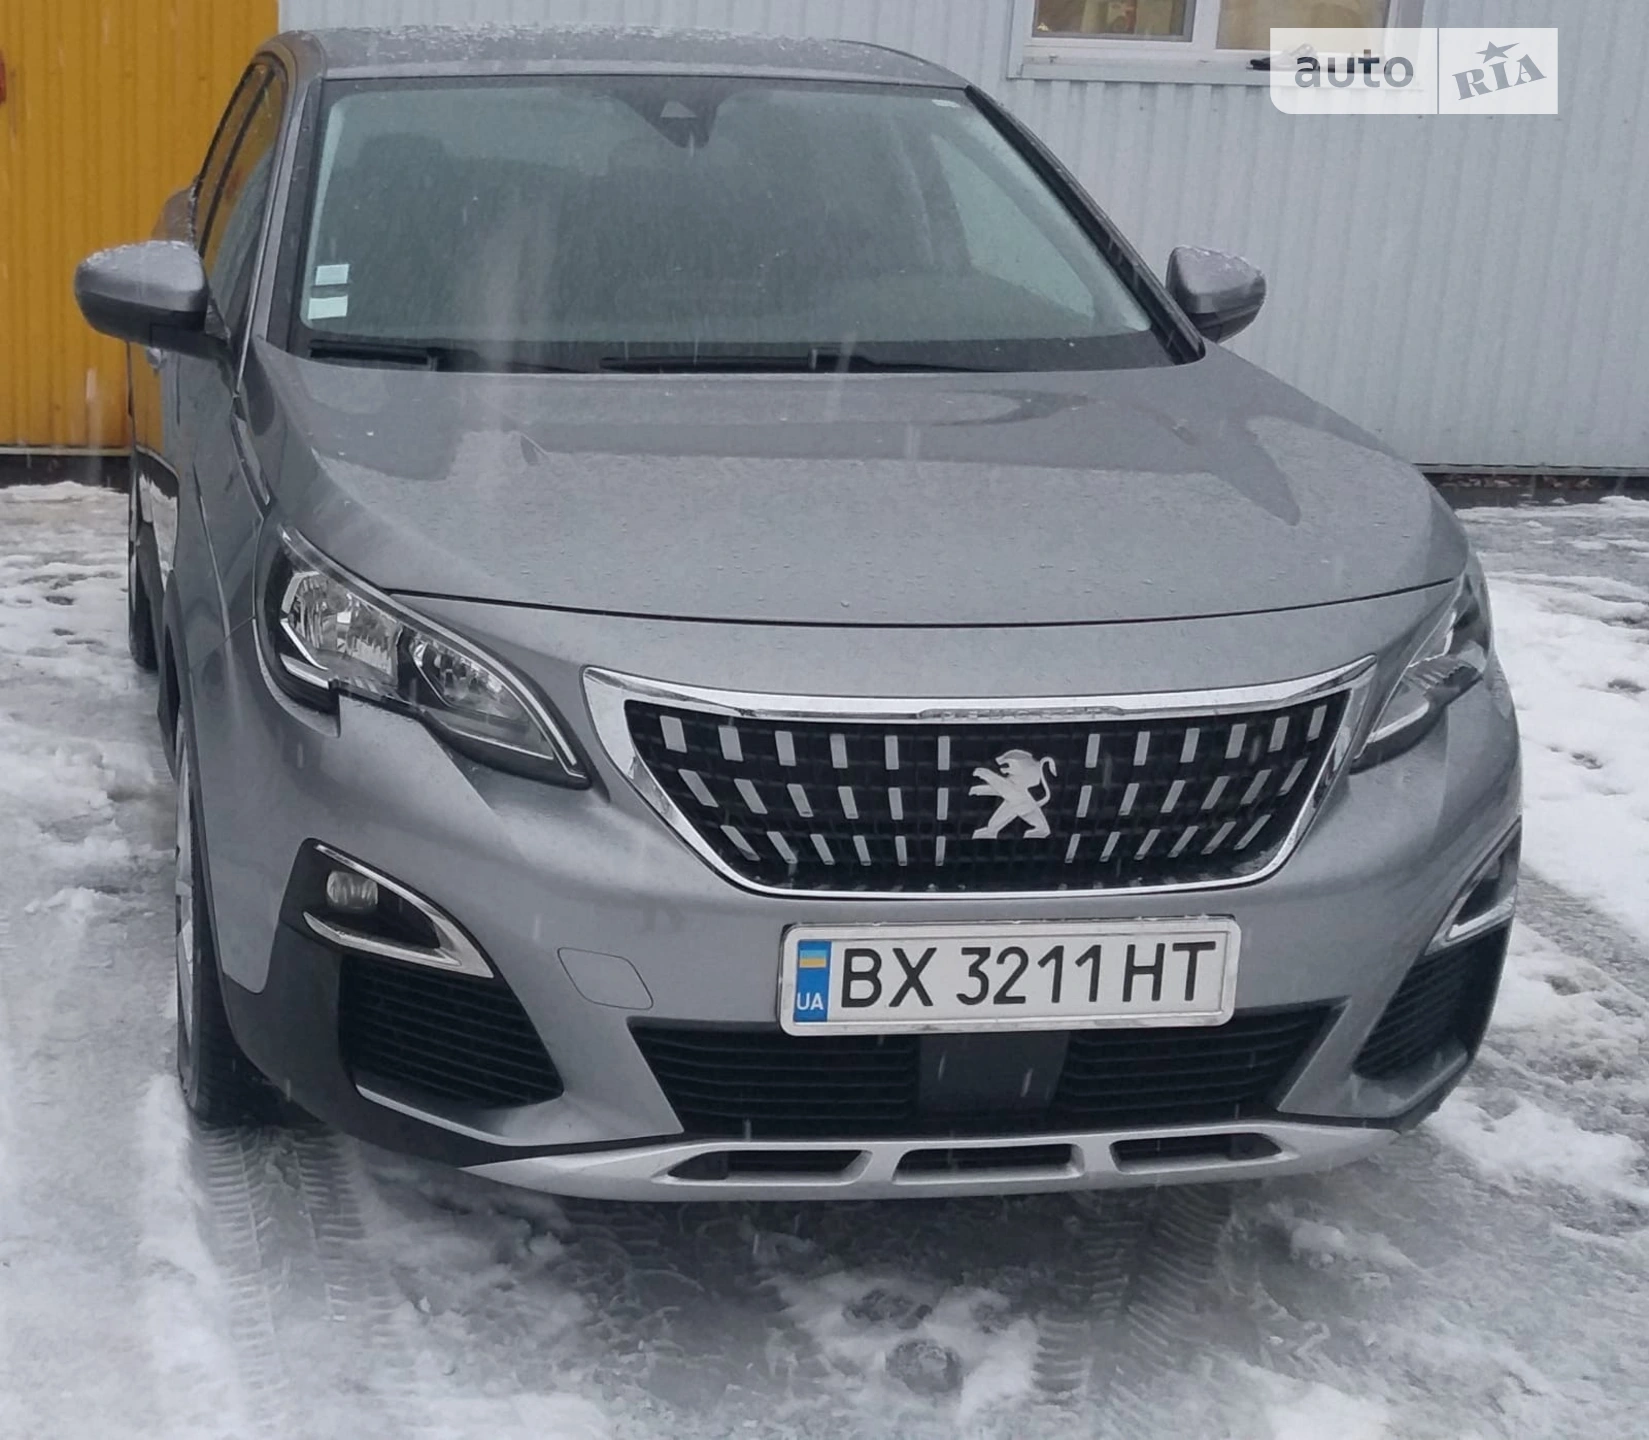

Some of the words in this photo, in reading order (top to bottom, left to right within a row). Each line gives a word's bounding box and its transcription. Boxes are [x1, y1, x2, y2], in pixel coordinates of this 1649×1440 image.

[840, 946, 938, 1008] BX
[956, 944, 1102, 1006] 3211
[1121, 940, 1217, 1002] HT
[795, 992, 824, 1011] UA
